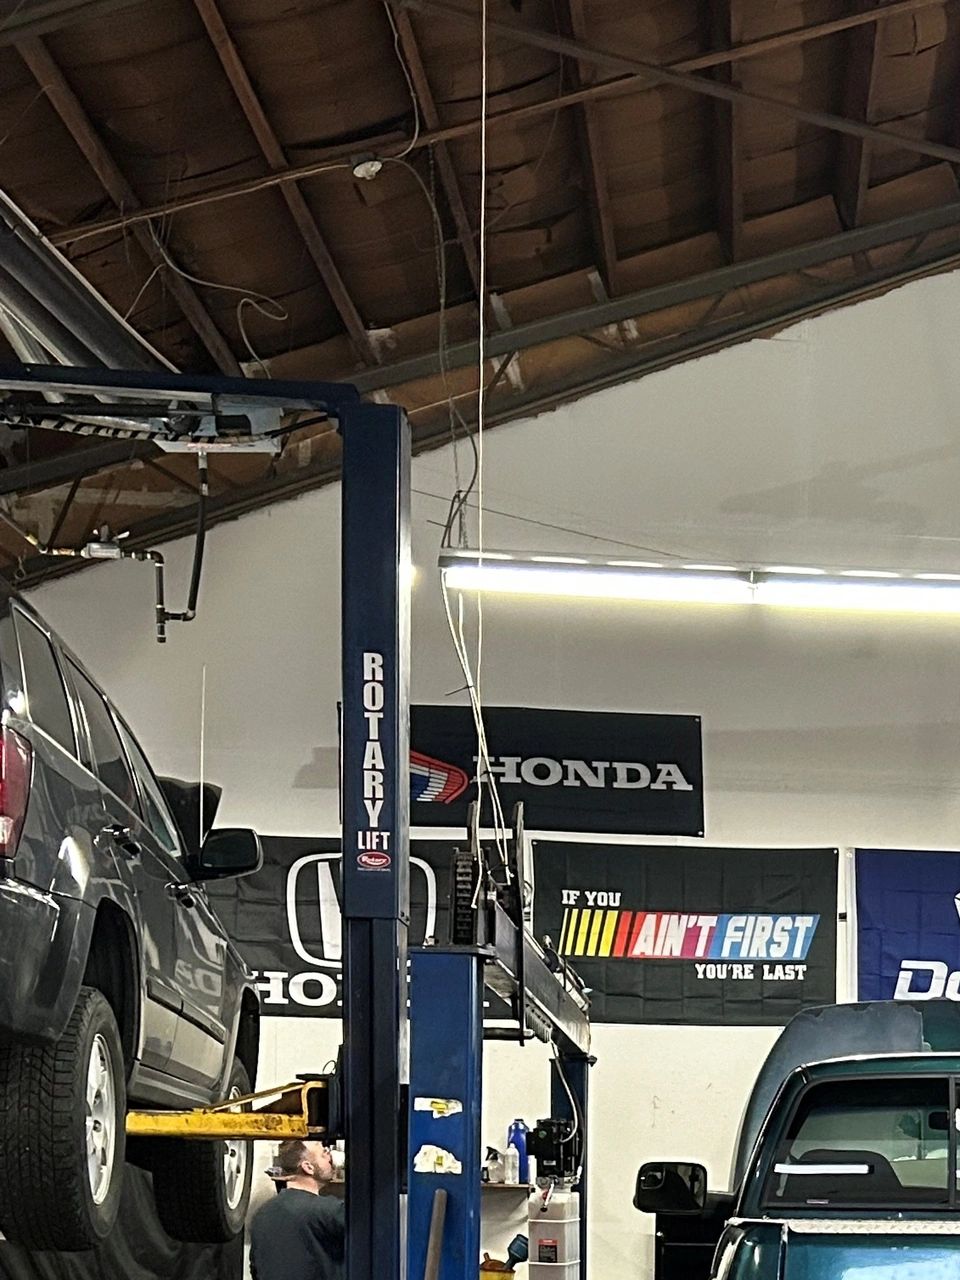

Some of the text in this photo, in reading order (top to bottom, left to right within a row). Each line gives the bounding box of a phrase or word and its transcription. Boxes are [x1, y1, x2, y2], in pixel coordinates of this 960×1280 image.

[363, 652, 385, 828] ROTARY
[470, 756, 694, 791] HONDA
[357, 830, 391, 850] LIFT
[561, 889, 621, 907] IF YOU
[631, 914, 815, 958] AIN'T FIRST
[695, 964, 807, 981] YOU'RE LAST
